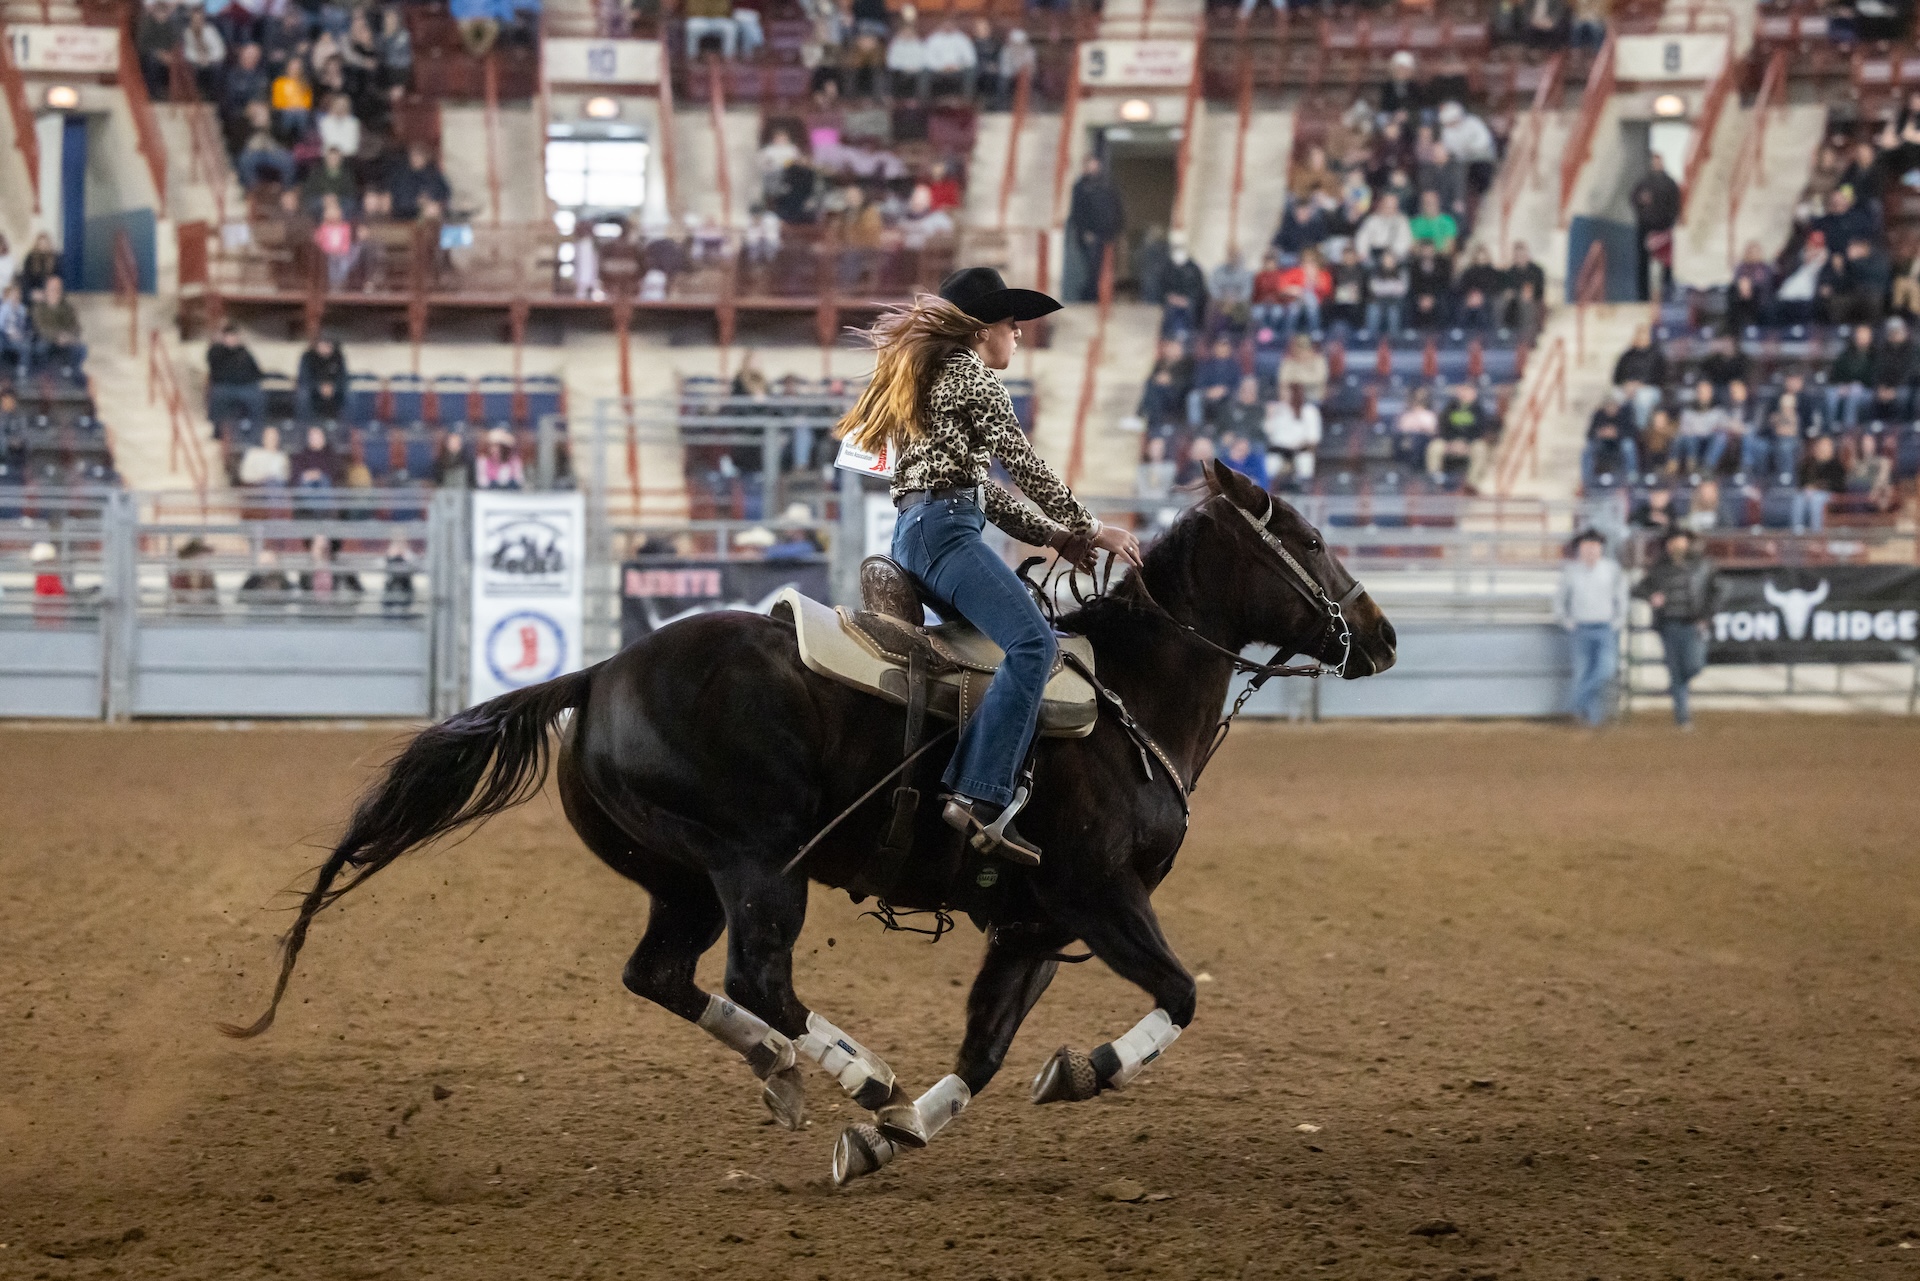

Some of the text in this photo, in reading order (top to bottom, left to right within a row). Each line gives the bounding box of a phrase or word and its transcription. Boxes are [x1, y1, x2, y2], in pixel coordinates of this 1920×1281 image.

[588, 47, 616, 75] 10
[1664, 43, 1681, 71] 8
[1812, 610, 1918, 642] RIDGE
